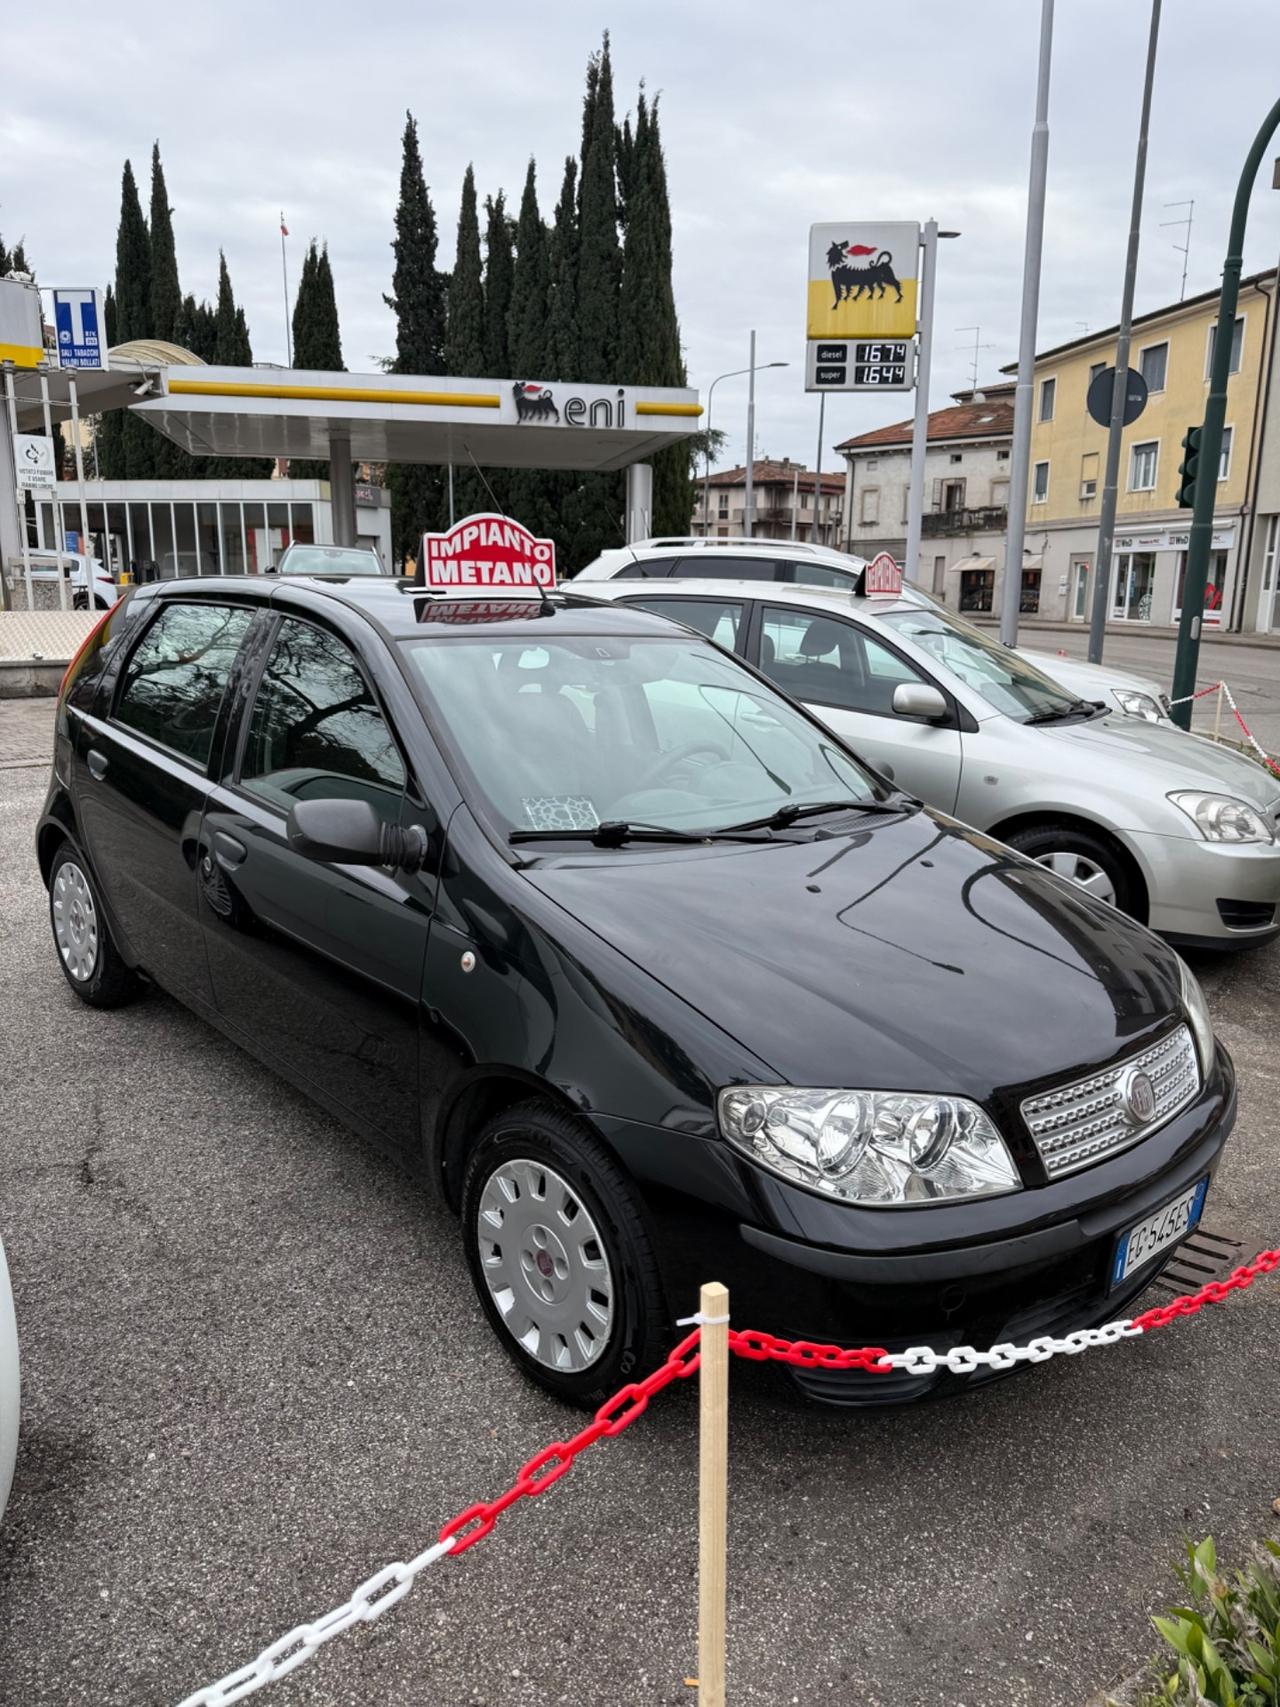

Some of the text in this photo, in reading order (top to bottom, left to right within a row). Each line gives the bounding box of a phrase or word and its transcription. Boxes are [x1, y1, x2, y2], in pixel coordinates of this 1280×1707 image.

[57, 291, 93, 346] T
[74, 349, 99, 357] TABACCHI
[821, 351, 842, 359] diesel
[820, 371, 841, 379] super
[564, 388, 625, 427] eni
[431, 522, 551, 561] IMPIANTO
[431, 560, 551, 585] METANO
